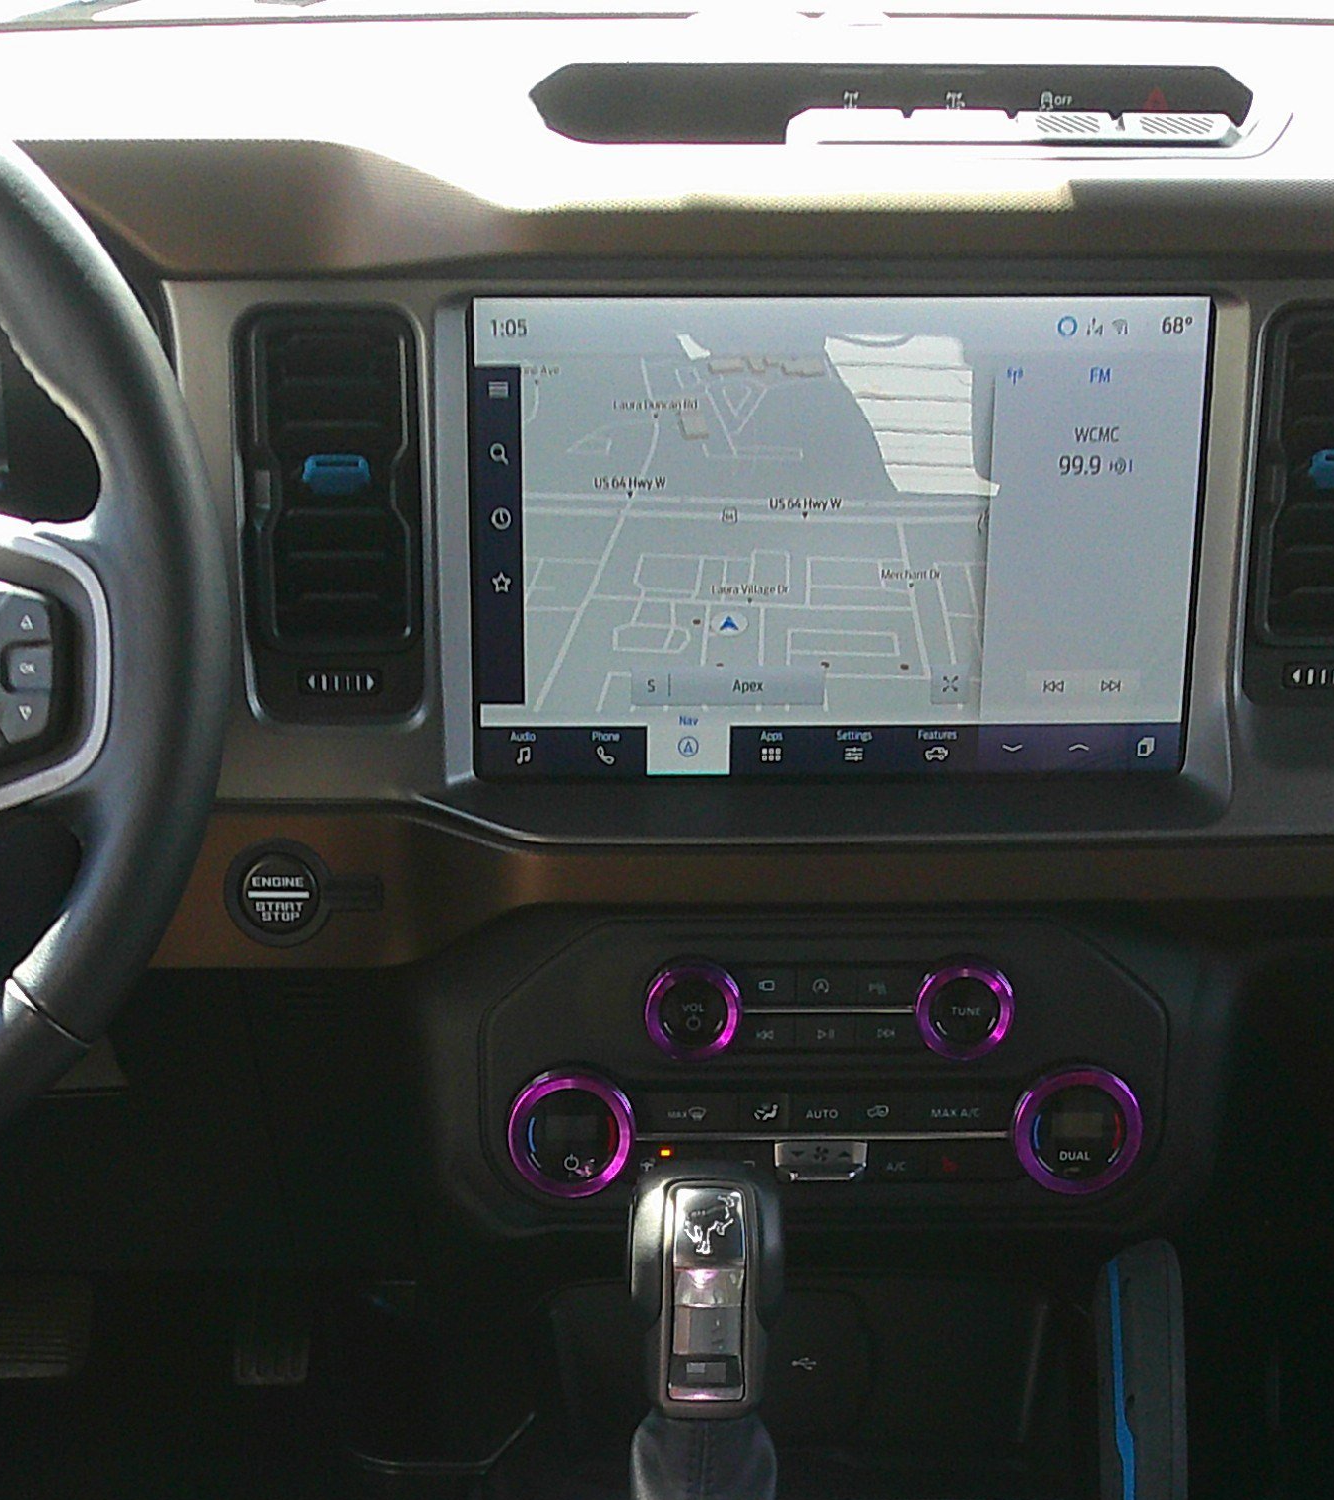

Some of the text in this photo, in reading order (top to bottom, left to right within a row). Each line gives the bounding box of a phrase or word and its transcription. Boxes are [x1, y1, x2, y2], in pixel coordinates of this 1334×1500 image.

[489, 318, 529, 338] 1:05
[1161, 315, 1194, 335] 68°
[1089, 366, 1112, 384] FM
[1073, 426, 1120, 443] WCMC
[1057, 454, 1102, 476] 99.9
[593, 476, 610, 489] US
[628, 476, 653, 491] Hwy
[654, 476, 666, 489] W
[769, 497, 842, 512] US 64 Hwy W
[880, 568, 927, 580] Merchant
[740, 584, 776, 597] Village
[646, 679, 657, 693] S
[732, 678, 764, 694] Apex
[678, 715, 699, 727] Nav
[509, 730, 537, 743] Audio
[591, 730, 621, 742] Phone
[760, 730, 784, 743] Apps
[835, 729, 873, 743] Settings
[917, 728, 958, 741] Features
[251, 876, 305, 888] ENGINE
[254, 900, 304, 912] START
[261, 911, 301, 922] STOP
[682, 1002, 705, 1013] VOL
[951, 1006, 981, 1018] TUNE
[805, 1108, 839, 1120] AUTO
[930, 1107, 980, 1118] MAX A/C
[1058, 1150, 1091, 1161] DUAL
[885, 1160, 907, 1172] A/C
